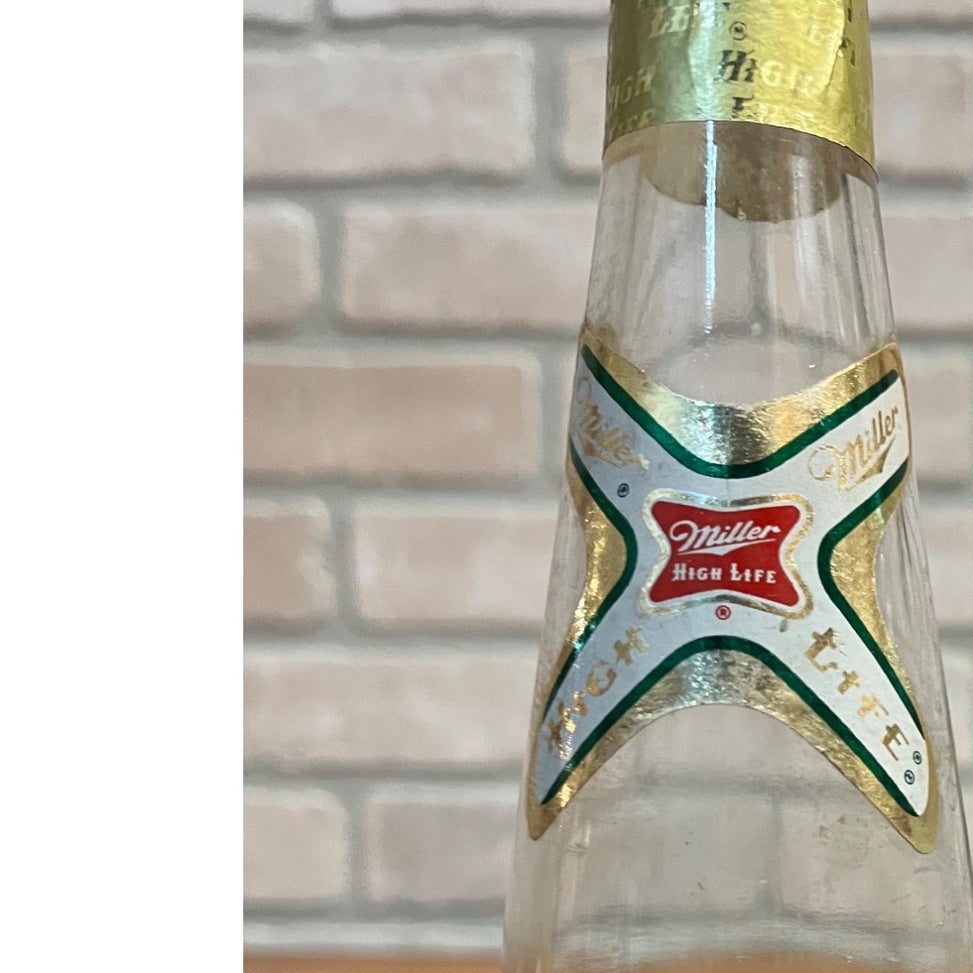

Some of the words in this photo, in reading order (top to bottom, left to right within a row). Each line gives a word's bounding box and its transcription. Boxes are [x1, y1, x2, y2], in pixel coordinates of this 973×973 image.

[807, 406, 899, 491] Miller
[669, 519, 781, 555] Miller
[672, 562, 722, 583] HIGH
[730, 562, 777, 584] LIFE
[804, 626, 909, 761] LIFE
